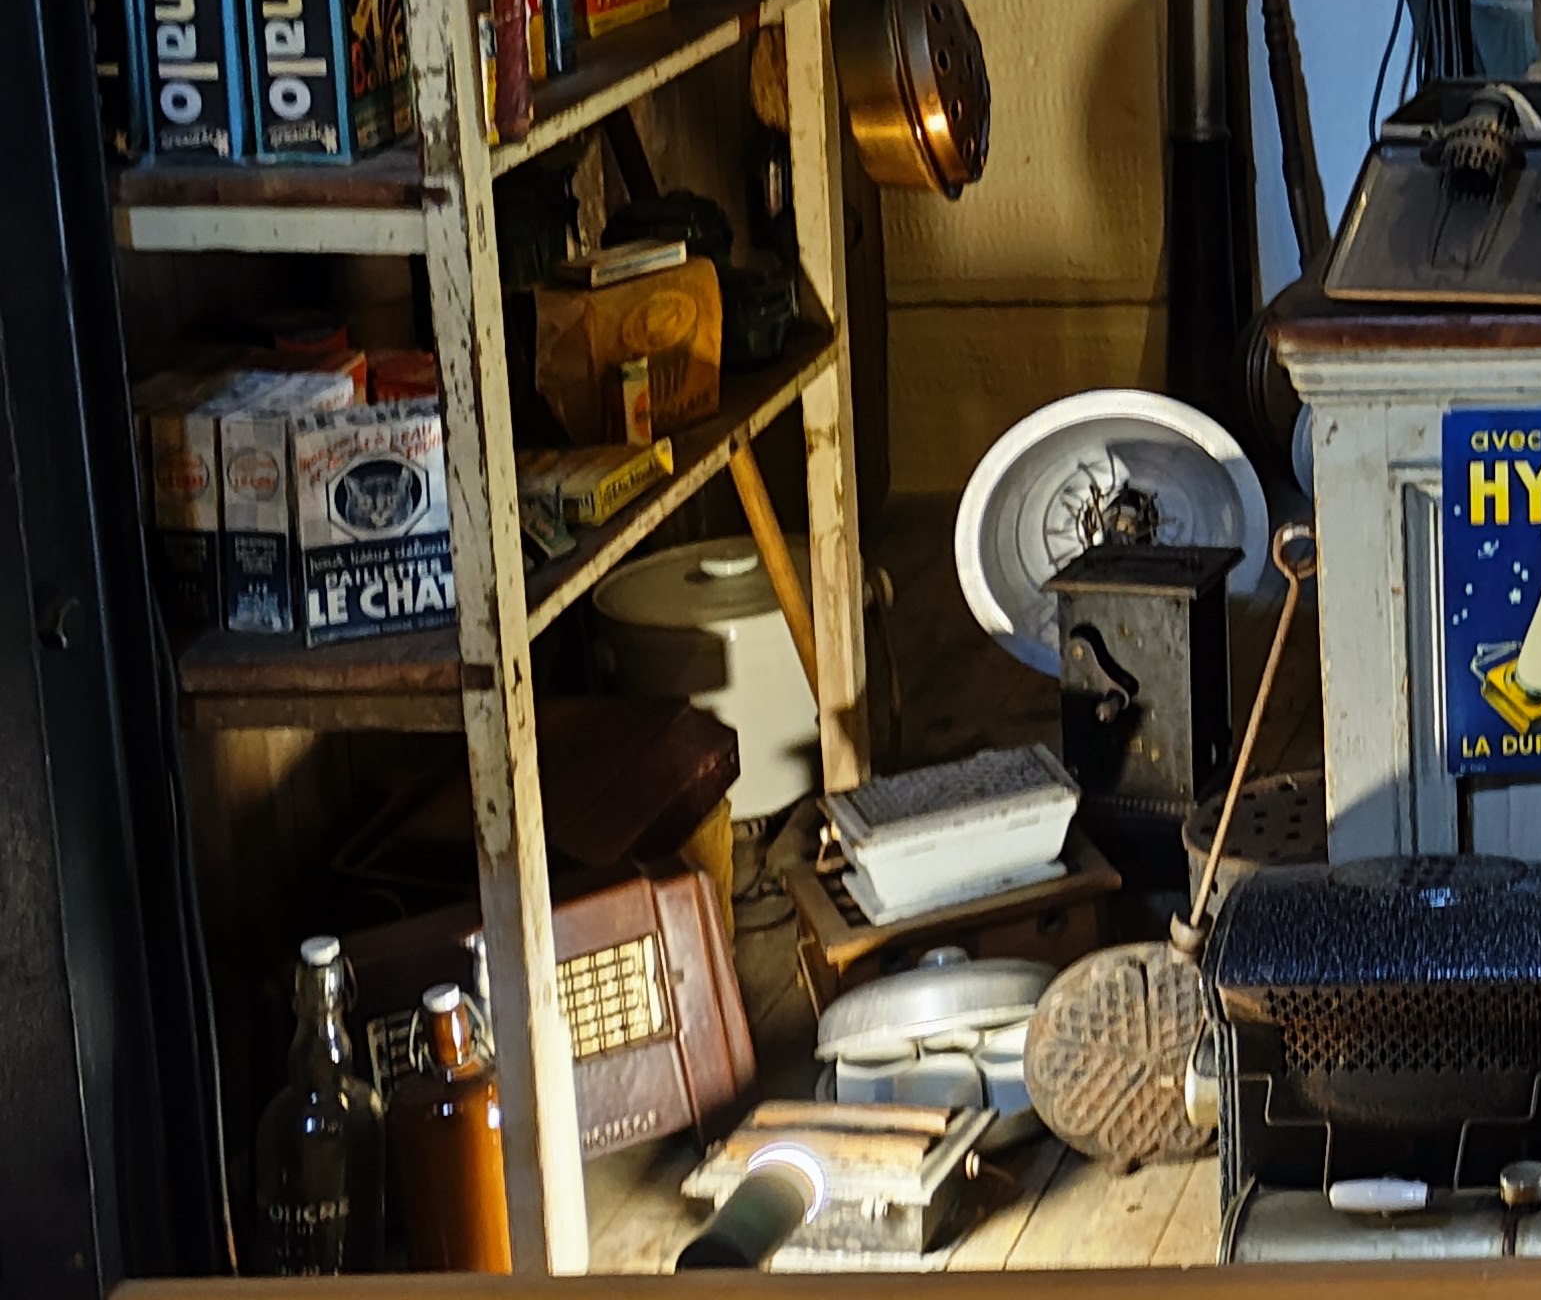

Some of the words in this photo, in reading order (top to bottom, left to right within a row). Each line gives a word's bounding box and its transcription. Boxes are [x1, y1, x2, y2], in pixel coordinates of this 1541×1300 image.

[307, 586, 349, 628] LE
[359, 570, 457, 622] CHAT
[1462, 733, 1491, 759] LA
